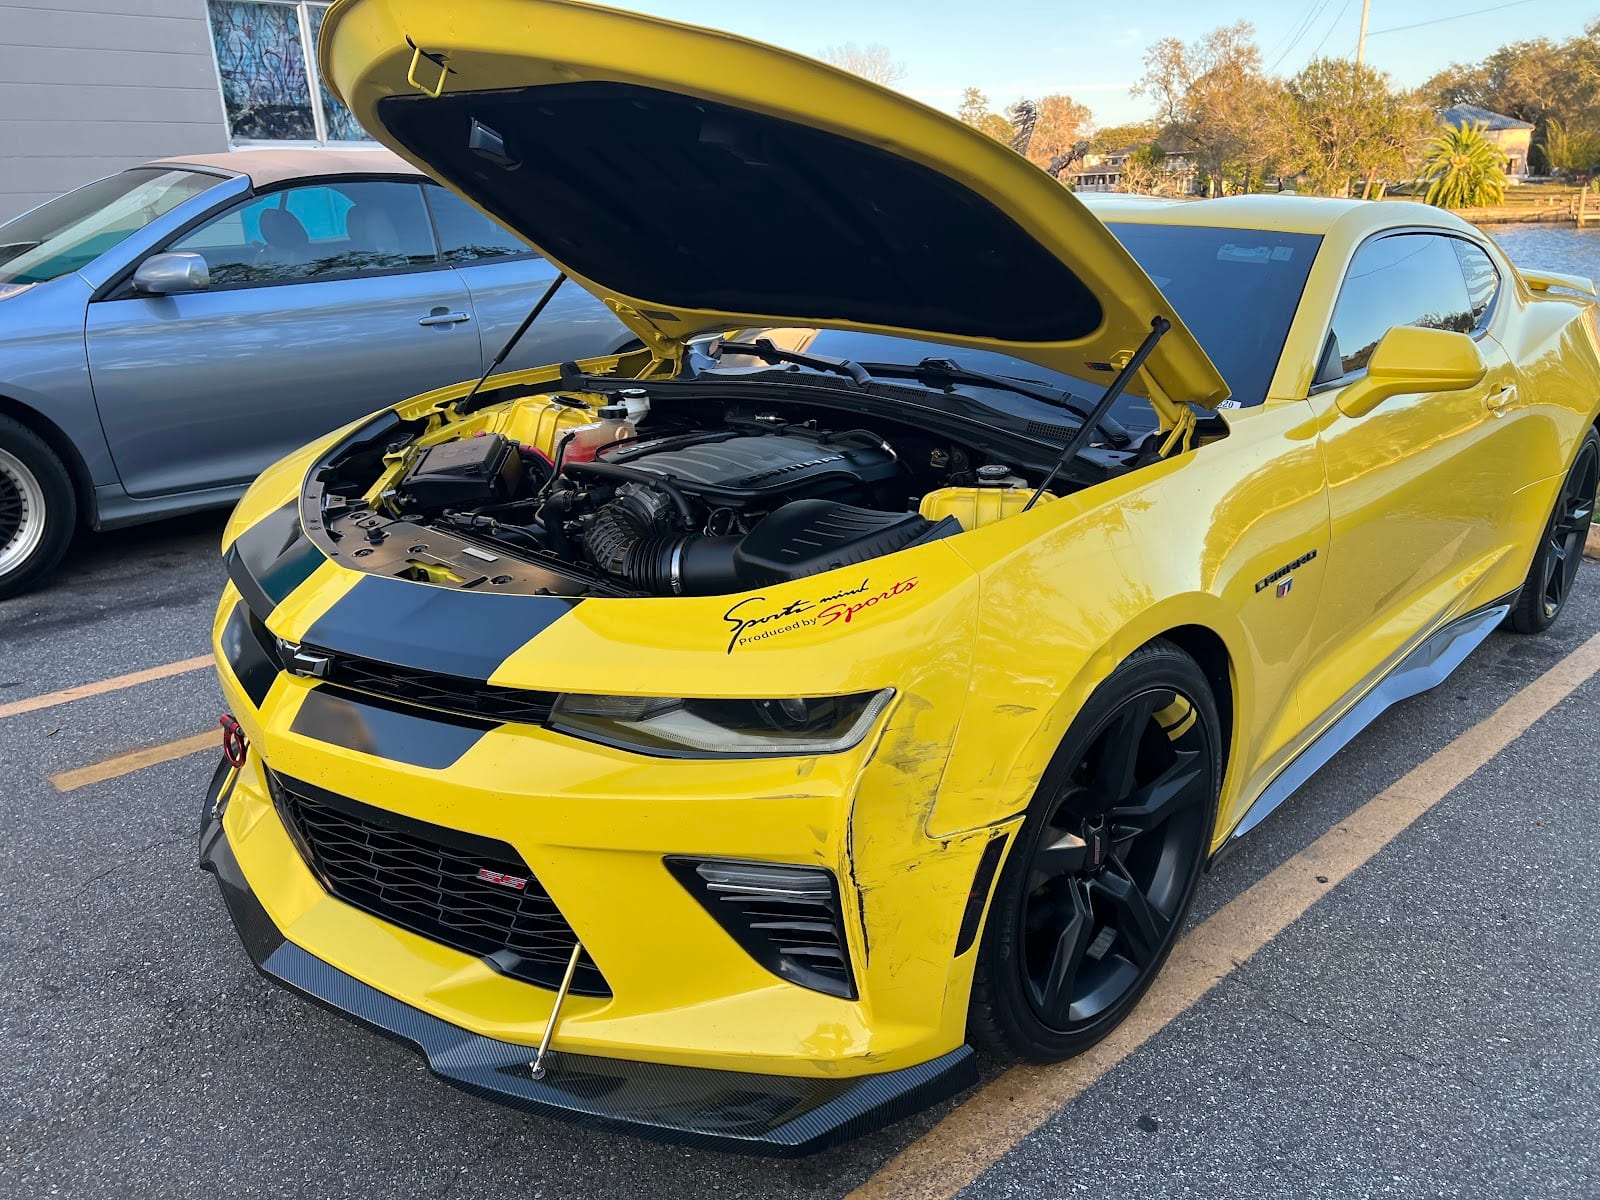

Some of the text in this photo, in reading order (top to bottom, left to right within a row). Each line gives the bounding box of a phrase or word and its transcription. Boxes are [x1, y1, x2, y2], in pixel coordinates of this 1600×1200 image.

[1255, 549, 1317, 593] CAMARO
[724, 578, 869, 655] Sports mind
[738, 576, 919, 646] Produced by Sports
